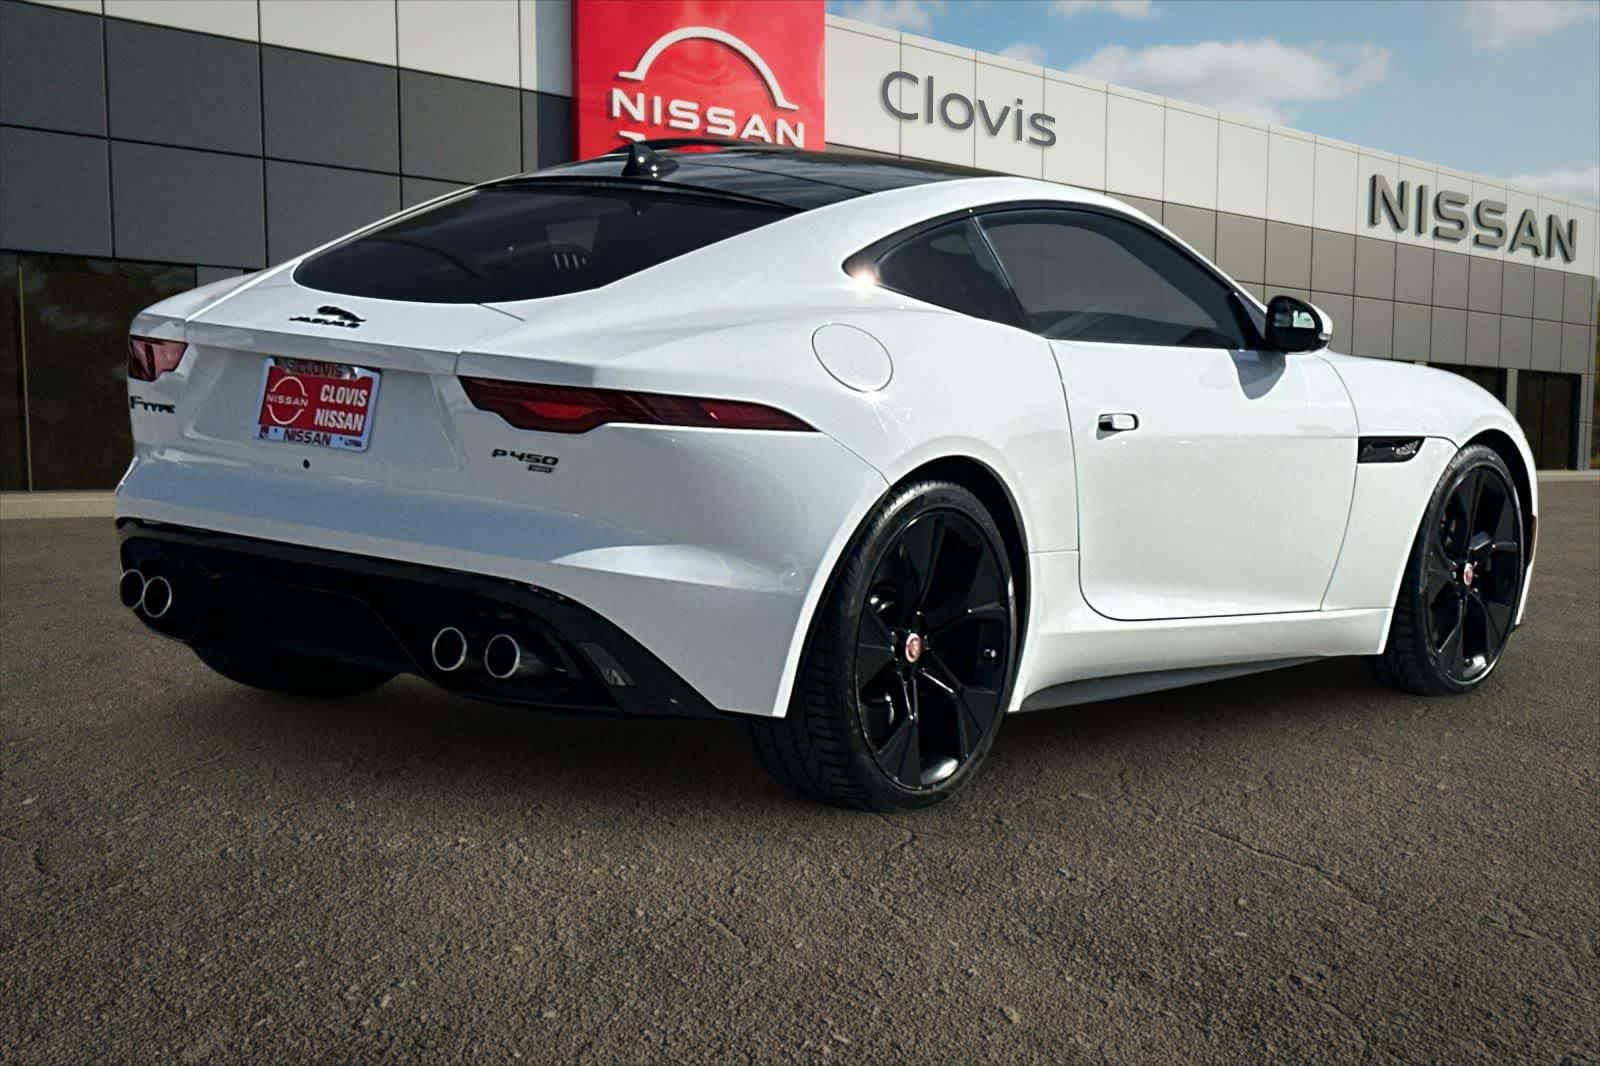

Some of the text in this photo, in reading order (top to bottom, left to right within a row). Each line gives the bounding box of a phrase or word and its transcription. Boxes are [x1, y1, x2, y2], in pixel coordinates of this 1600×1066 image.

[611, 87, 805, 148] NISSAN
[881, 70, 1058, 147] Clovis
[1368, 174, 1577, 263] NISSAN
[266, 393, 309, 407] NISSAN
[320, 384, 368, 407] CLOVIS
[314, 408, 365, 431] NISSAN
[283, 429, 331, 448] NISSAN
[492, 448, 559, 466] P450
